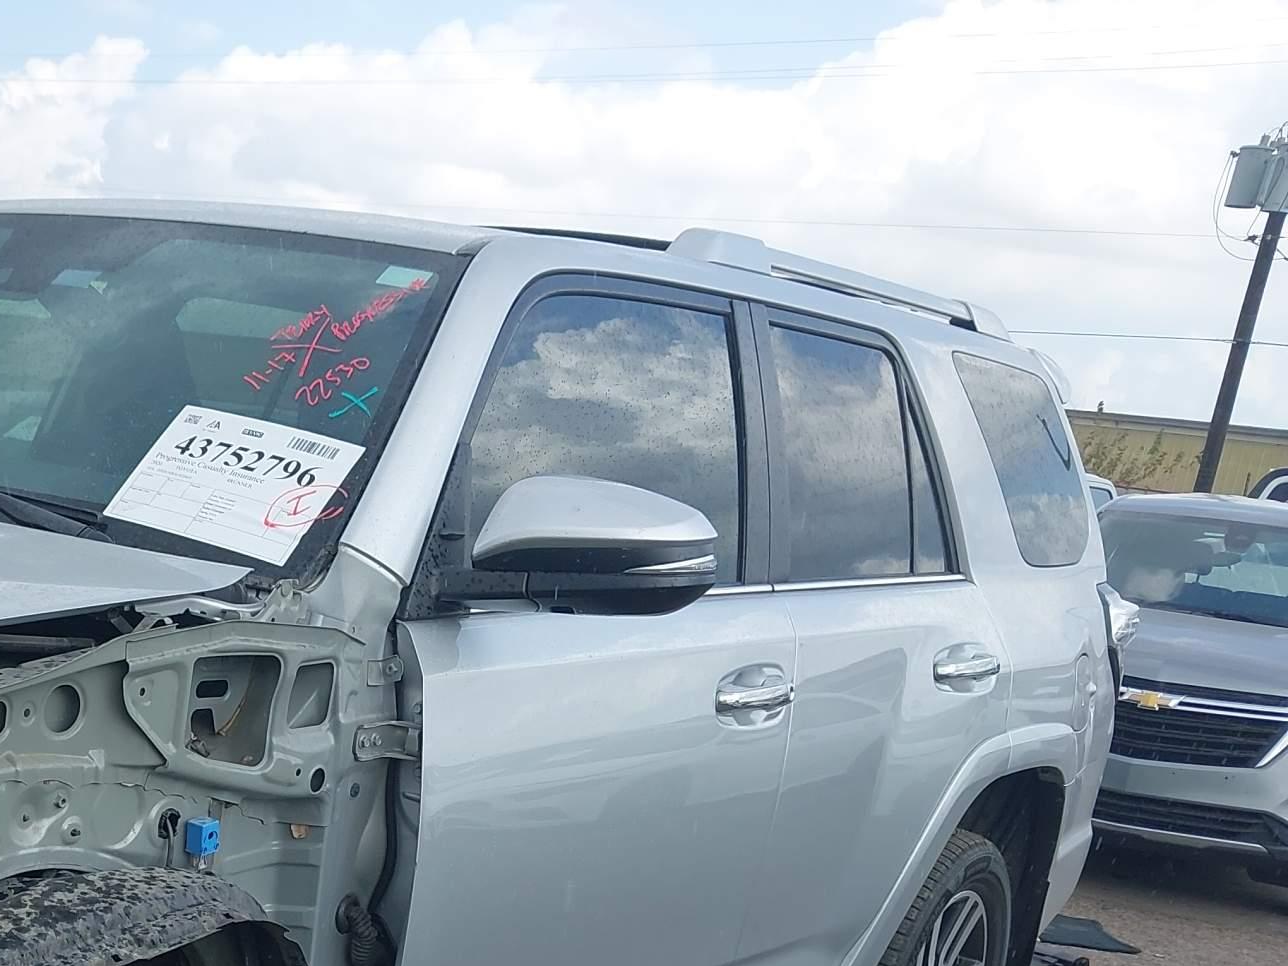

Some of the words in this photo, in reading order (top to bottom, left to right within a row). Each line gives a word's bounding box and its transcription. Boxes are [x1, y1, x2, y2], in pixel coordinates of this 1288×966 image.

[243, 351, 296, 390] 11-17
[295, 357, 370, 406] 22530
[174, 435, 324, 487] 43752796
